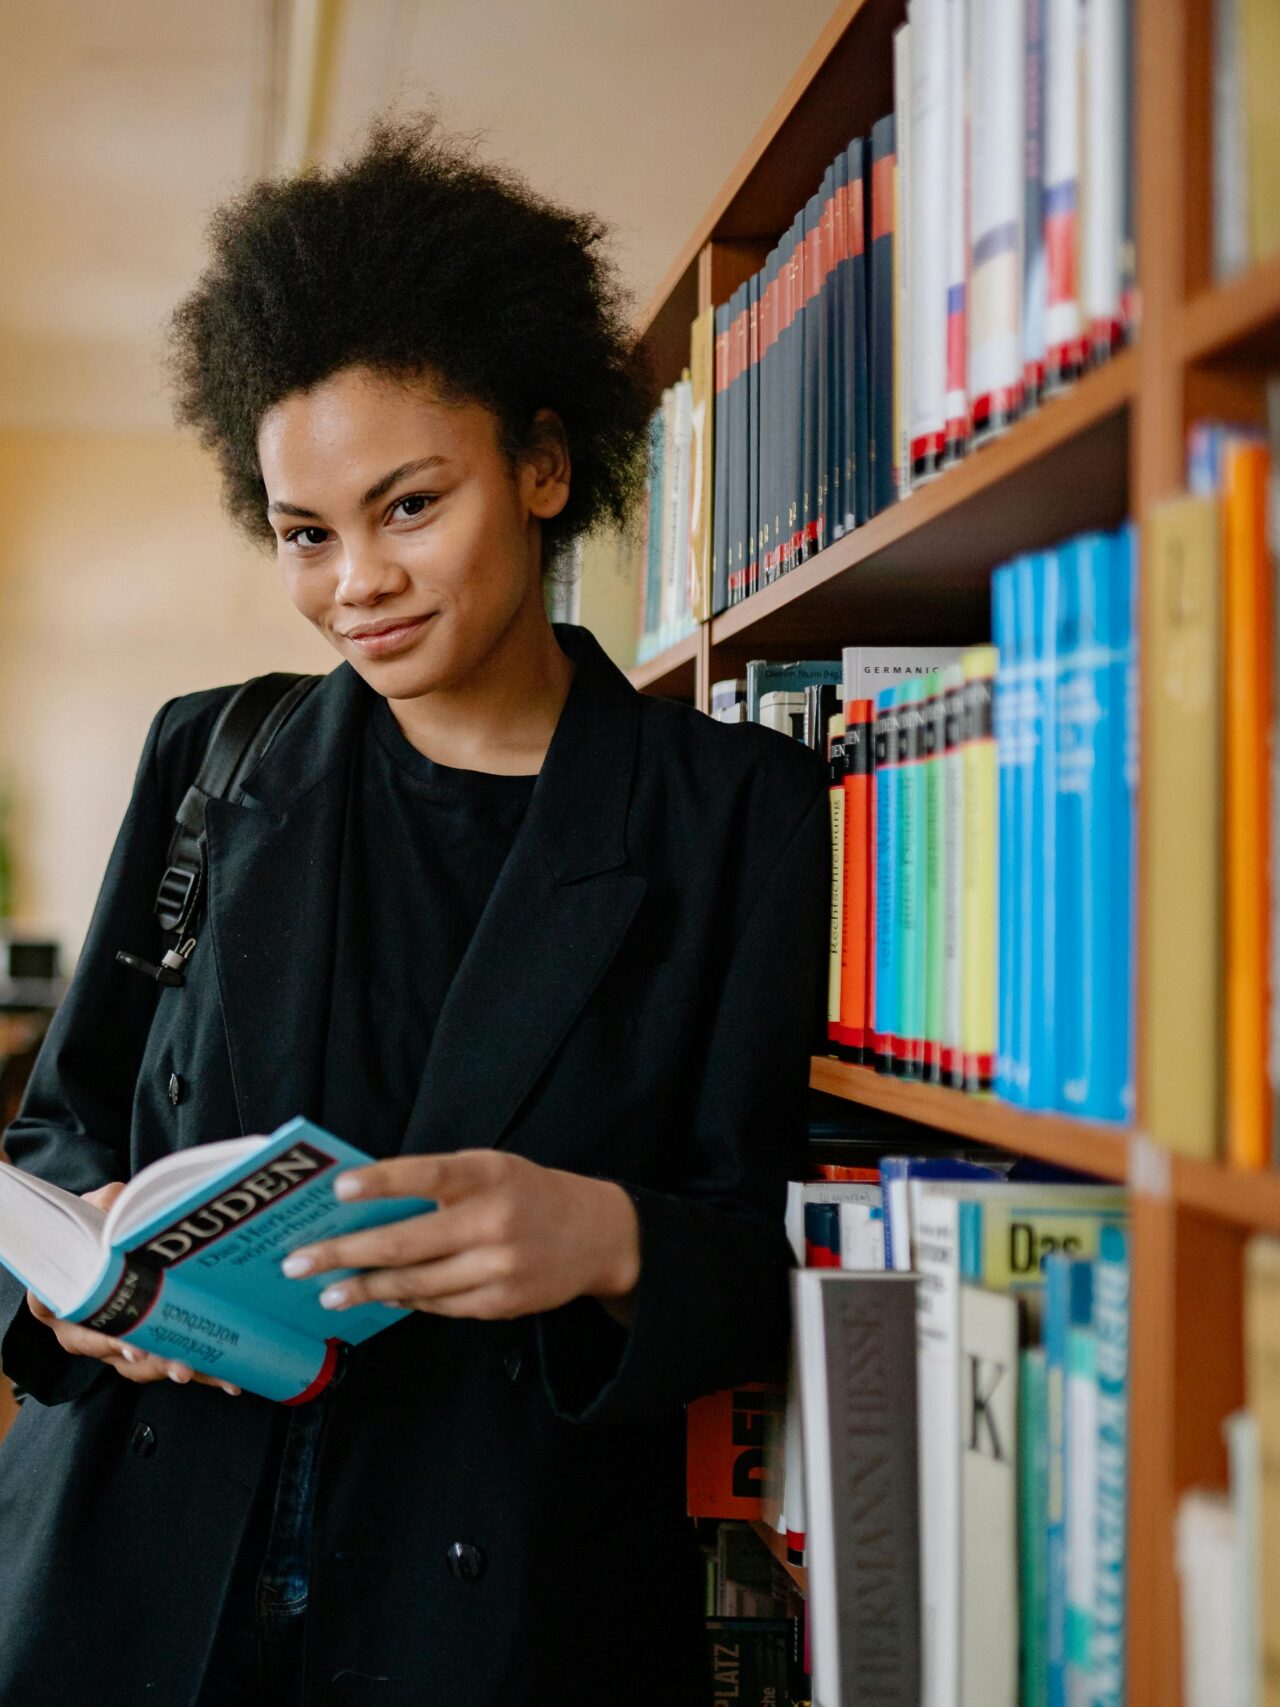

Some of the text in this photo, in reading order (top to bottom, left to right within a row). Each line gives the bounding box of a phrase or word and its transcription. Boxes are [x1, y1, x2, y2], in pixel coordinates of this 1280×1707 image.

[863, 666, 942, 675] GERMANIC
[149, 1149, 320, 1262] DUDEN
[91, 1271, 140, 1328] DUDEN 7
[161, 1303, 240, 1346] wörterbuch
[968, 1354, 1009, 1462] K
